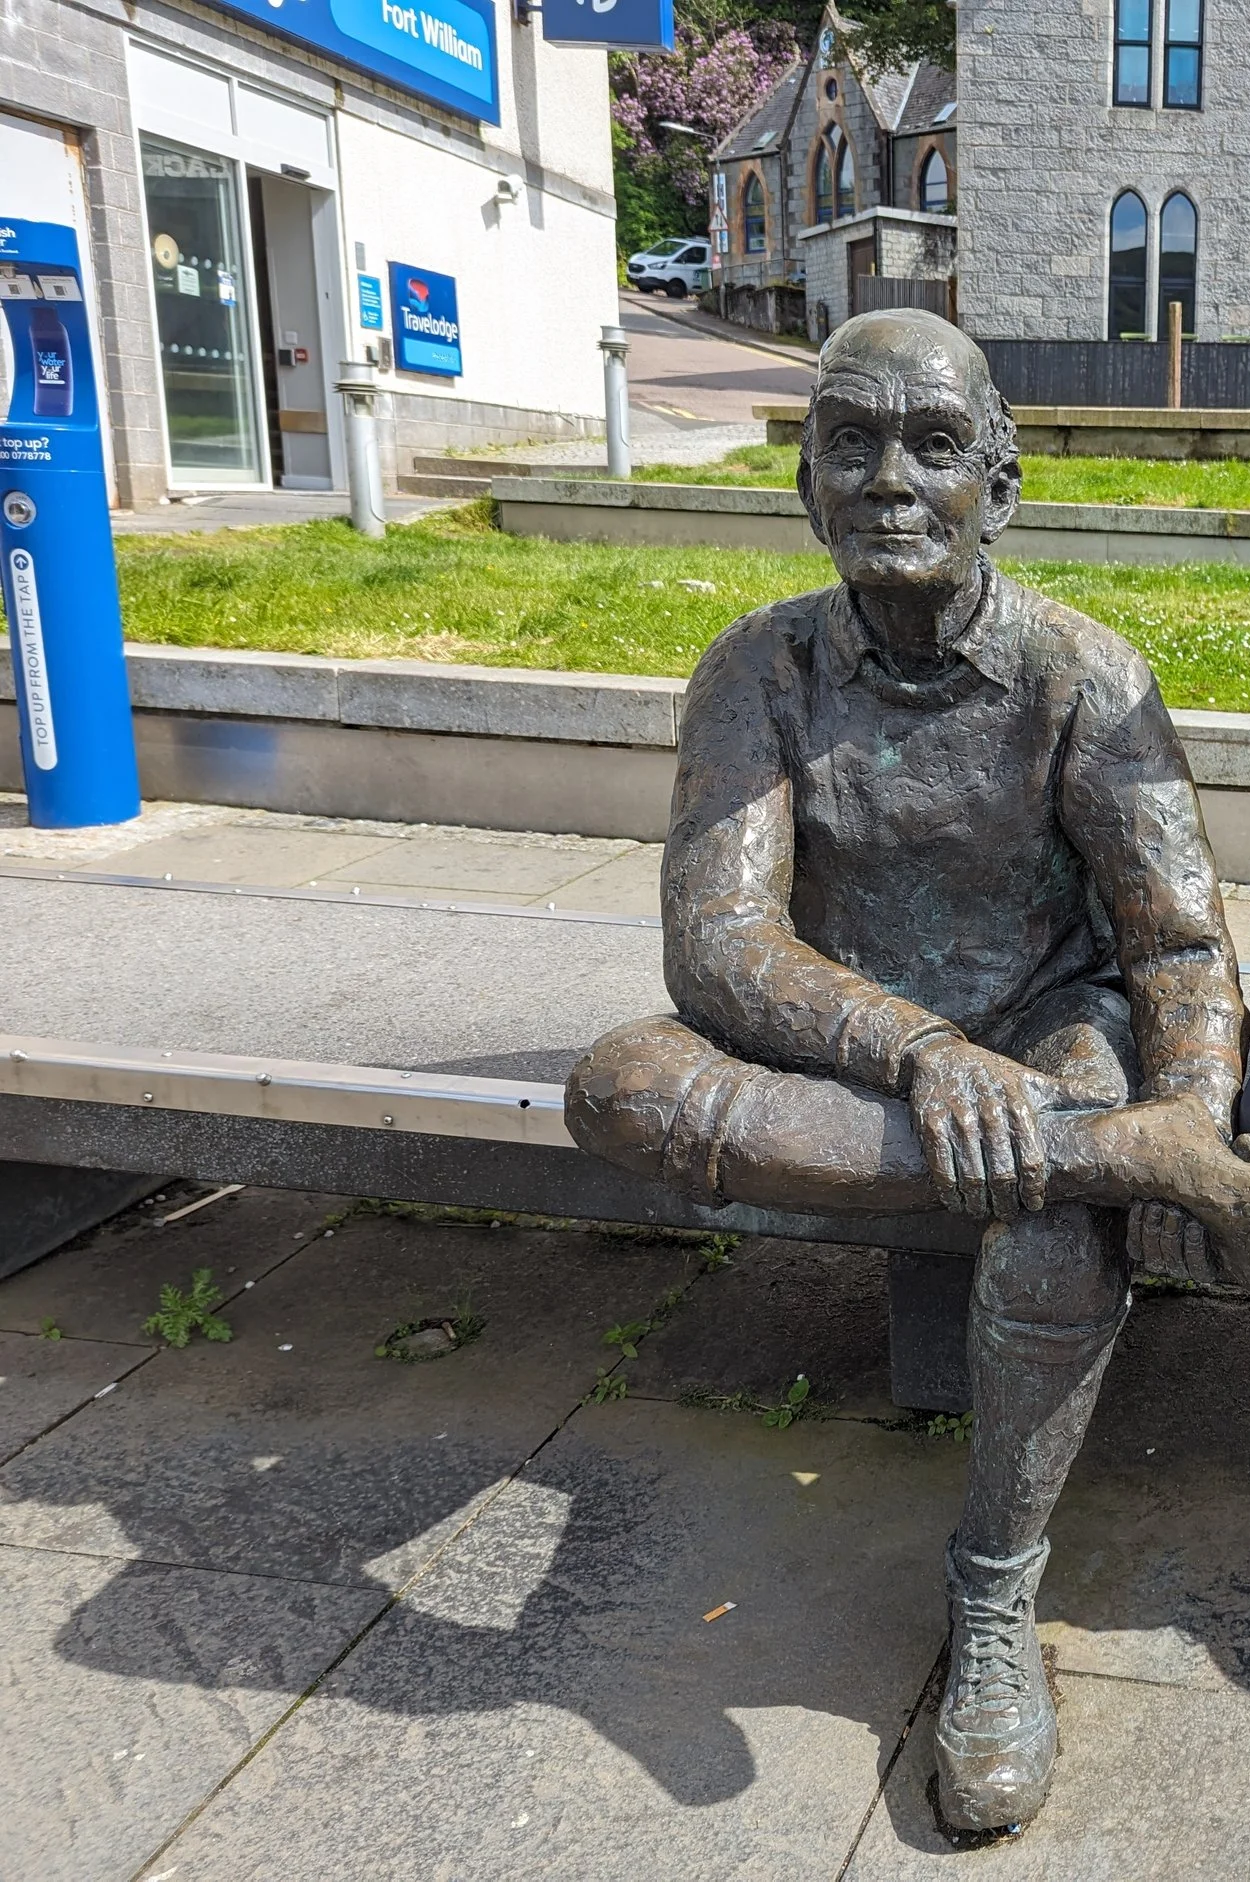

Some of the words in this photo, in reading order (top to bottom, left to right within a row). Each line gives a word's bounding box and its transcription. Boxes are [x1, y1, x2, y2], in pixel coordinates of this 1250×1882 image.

[382, 0, 419, 38] Fort
[420, 10, 483, 71] William
[0, 226, 16, 238] sh
[401, 305, 459, 342] Travelodge
[46, 371, 59, 379] life
[3, 438, 22, 451] top
[25, 436, 49, 451] up?
[12, 451, 51, 460] 0778778
[18, 575, 30, 603] TAP
[22, 608, 34, 638] THE
[27, 643, 42, 688] FROM
[32, 692, 45, 713] UP
[35, 717, 48, 747] TOP
